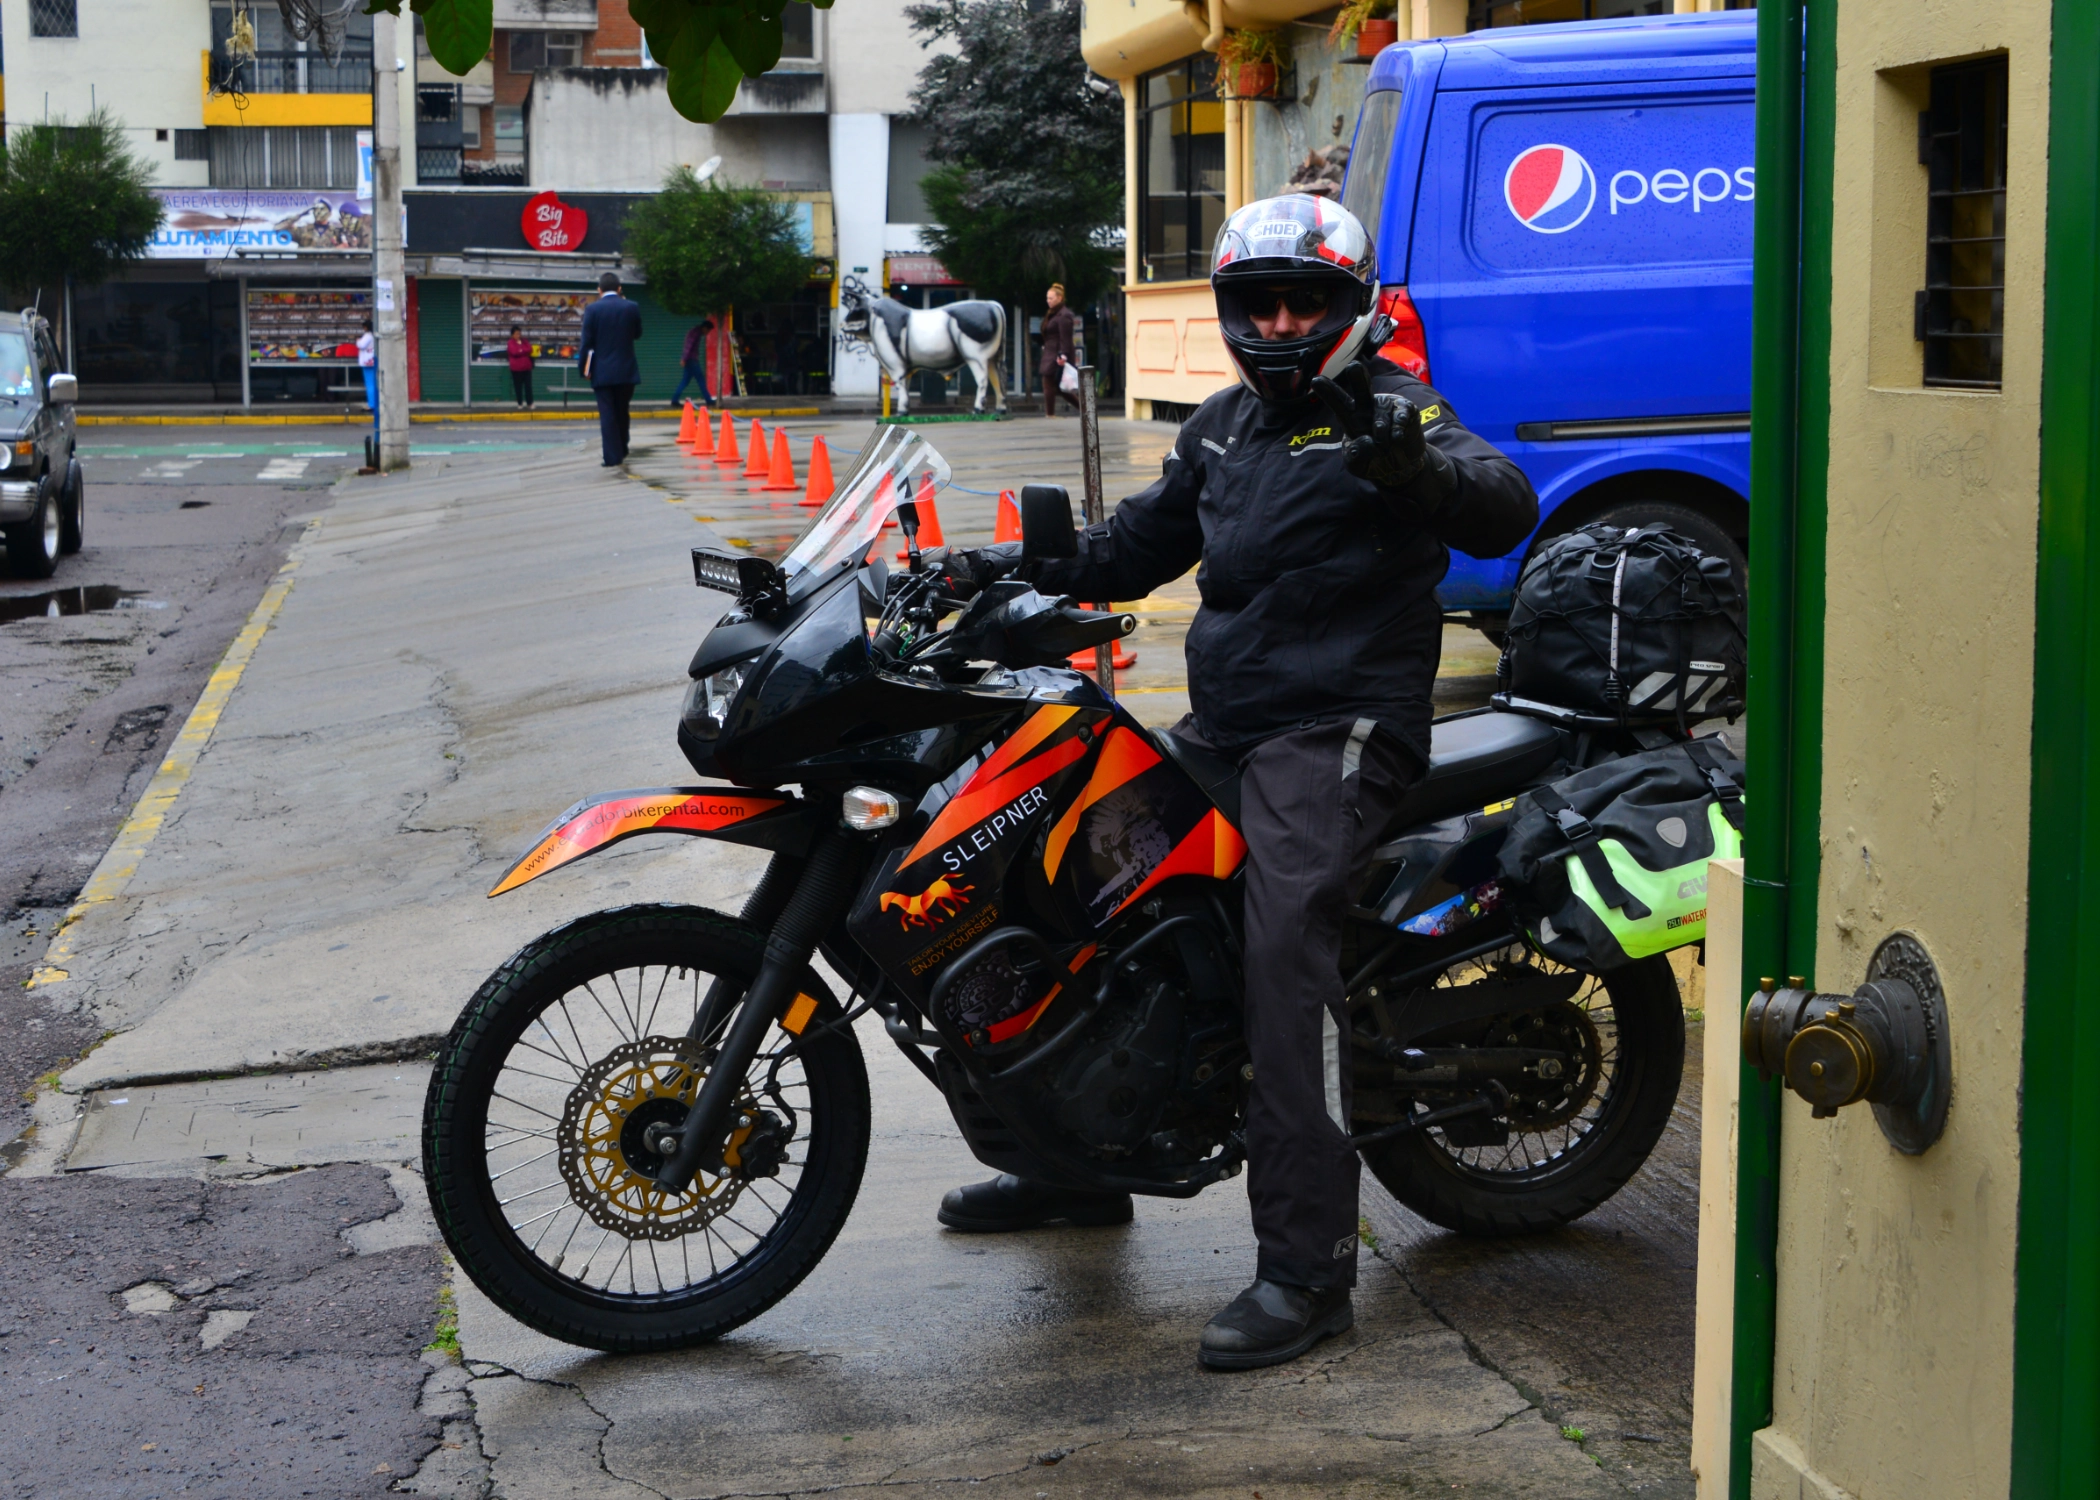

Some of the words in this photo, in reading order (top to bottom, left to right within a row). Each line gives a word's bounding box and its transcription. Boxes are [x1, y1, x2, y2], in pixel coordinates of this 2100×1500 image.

[213, 195, 309, 208] ECUATORIANA
[1610, 167, 1755, 215] peps
[536, 204, 562, 229] Big
[147, 230, 292, 246] LUTAMIENTO
[538, 229, 568, 247] Bite
[1254, 223, 1298, 238] SHOEI
[894, 262, 944, 271] CENTR
[1677, 874, 1708, 899] GIV
[907, 947, 935, 967] TAILOR
[934, 932, 956, 949] YOUR
[911, 948, 946, 976] ENJOY
[946, 909, 999, 951] YOURSELF
